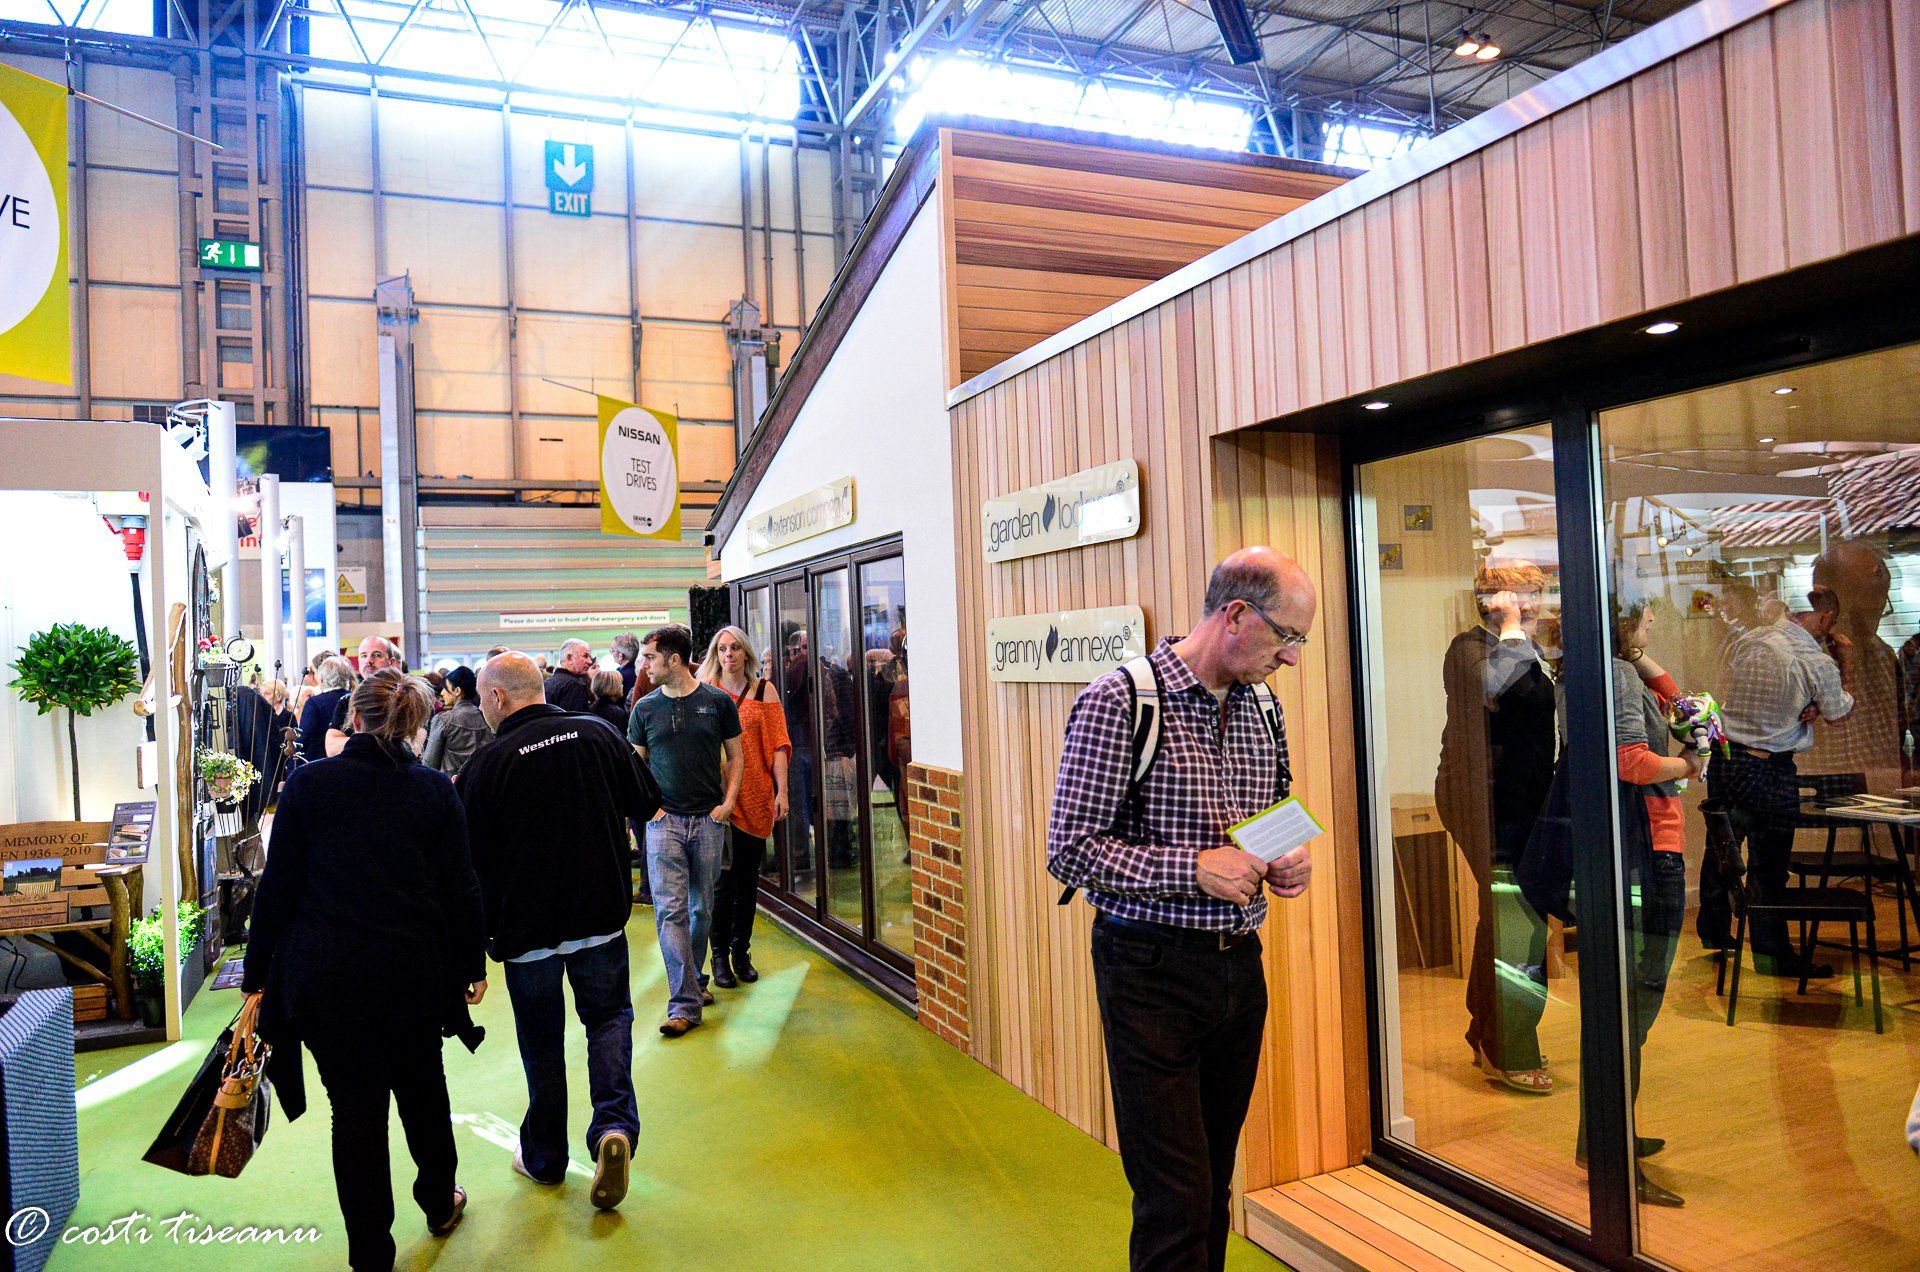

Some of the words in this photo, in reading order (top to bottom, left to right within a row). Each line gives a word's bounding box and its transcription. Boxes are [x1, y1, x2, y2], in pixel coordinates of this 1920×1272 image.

[554, 191, 588, 214] EXIT
[618, 425, 661, 446] NISSAN
[630, 457, 652, 475] TEST
[626, 472, 657, 491] DRIVES
[990, 507, 1041, 553] garden
[995, 639, 1043, 671] granny
[518, 731, 578, 755] Westfield
[4, 834, 67, 847] MEMORY
[70, 832, 89, 844] OF
[23, 848, 51, 860] 1936
[62, 845, 92, 857] 2010
